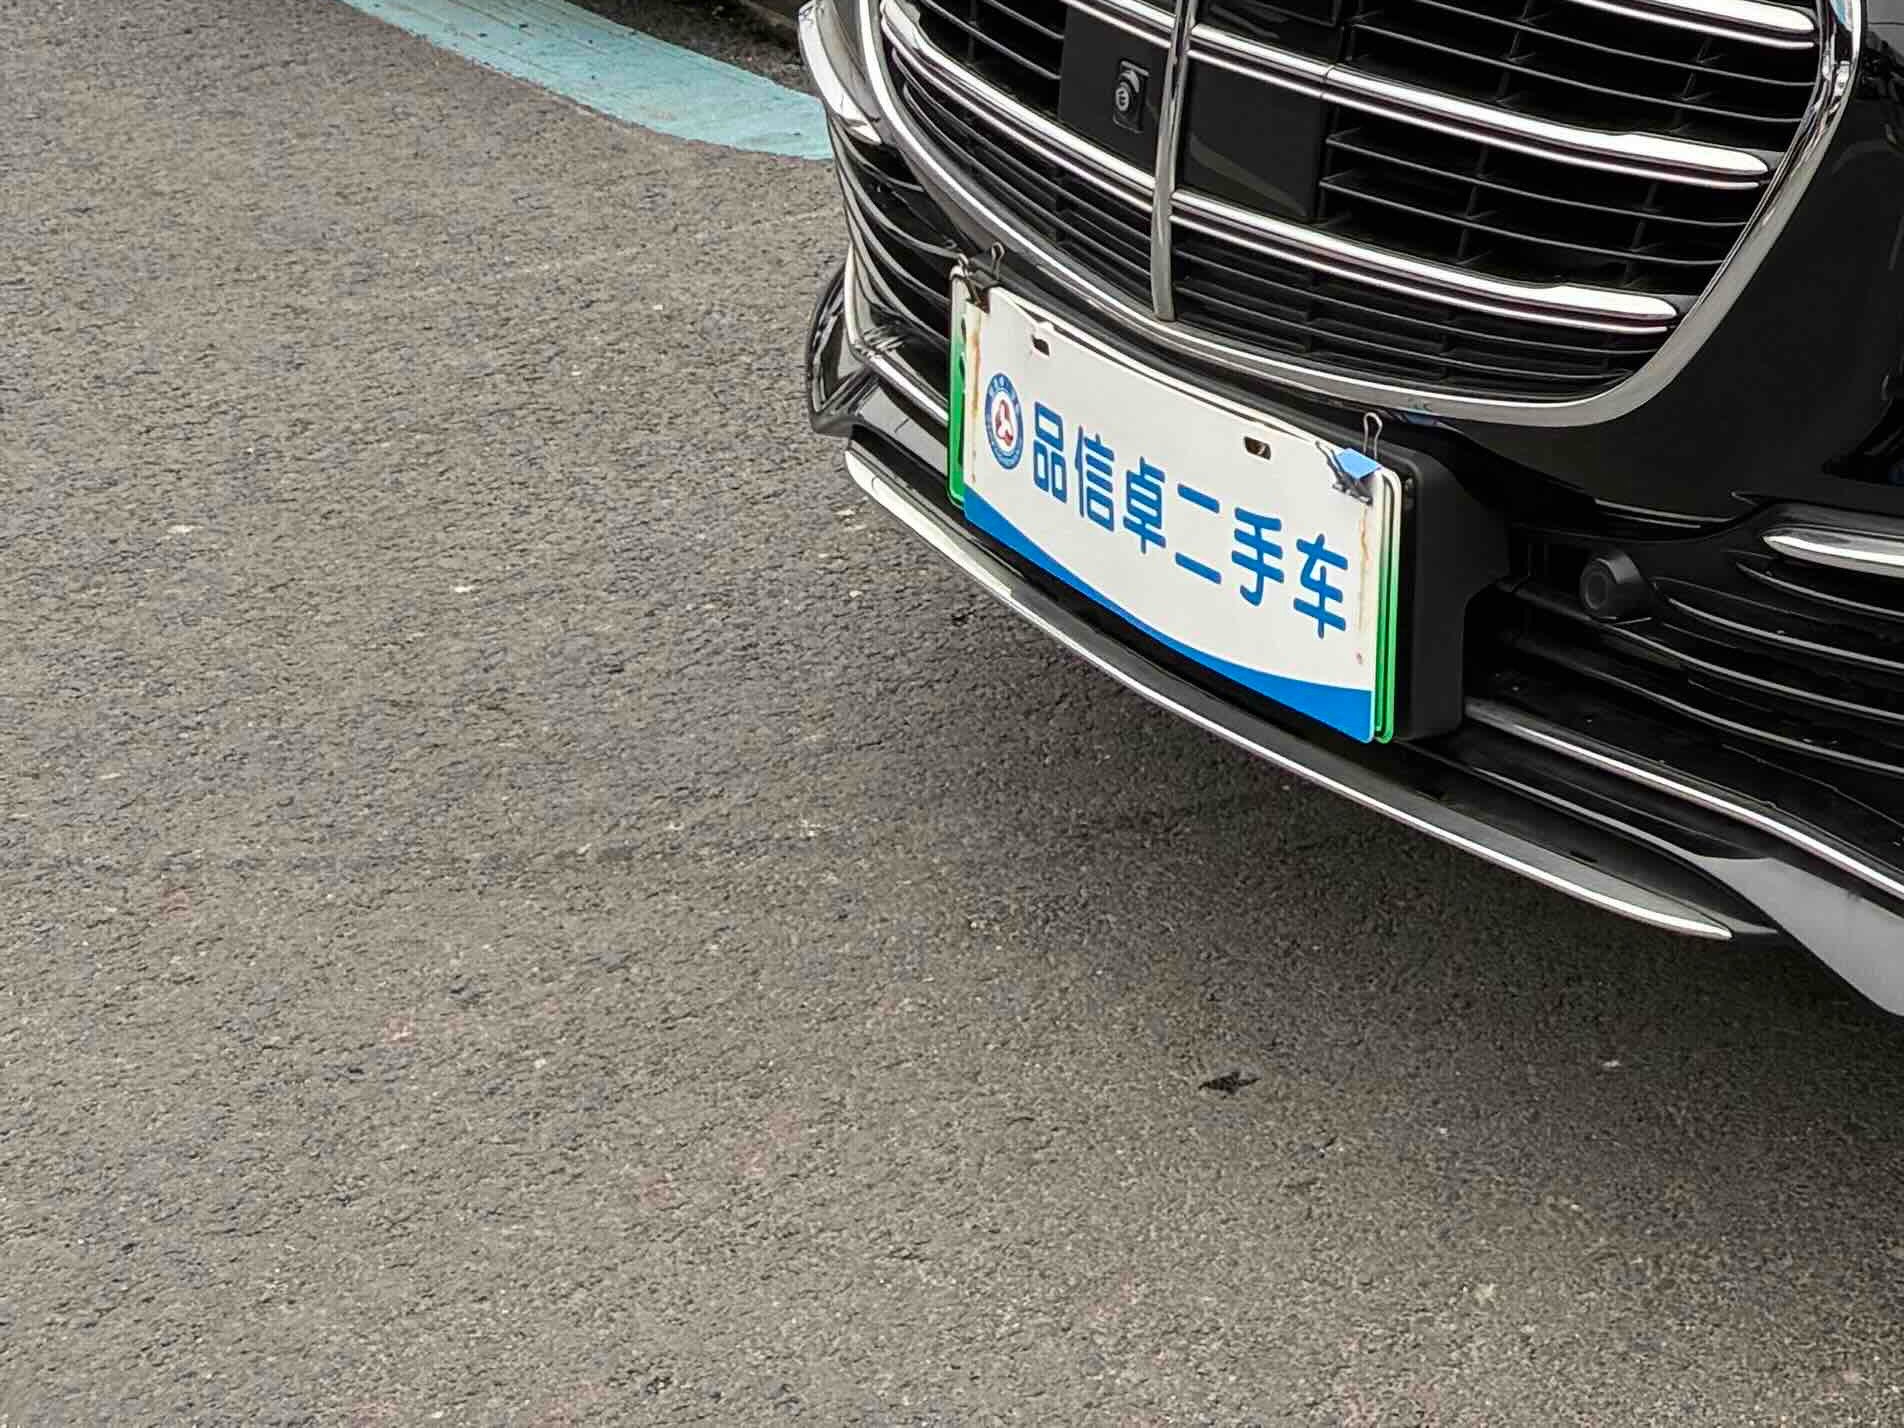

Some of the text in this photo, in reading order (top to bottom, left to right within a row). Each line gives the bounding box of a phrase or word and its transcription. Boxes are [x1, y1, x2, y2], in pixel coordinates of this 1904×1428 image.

[1032, 400, 1350, 640] 品信卓二手车
